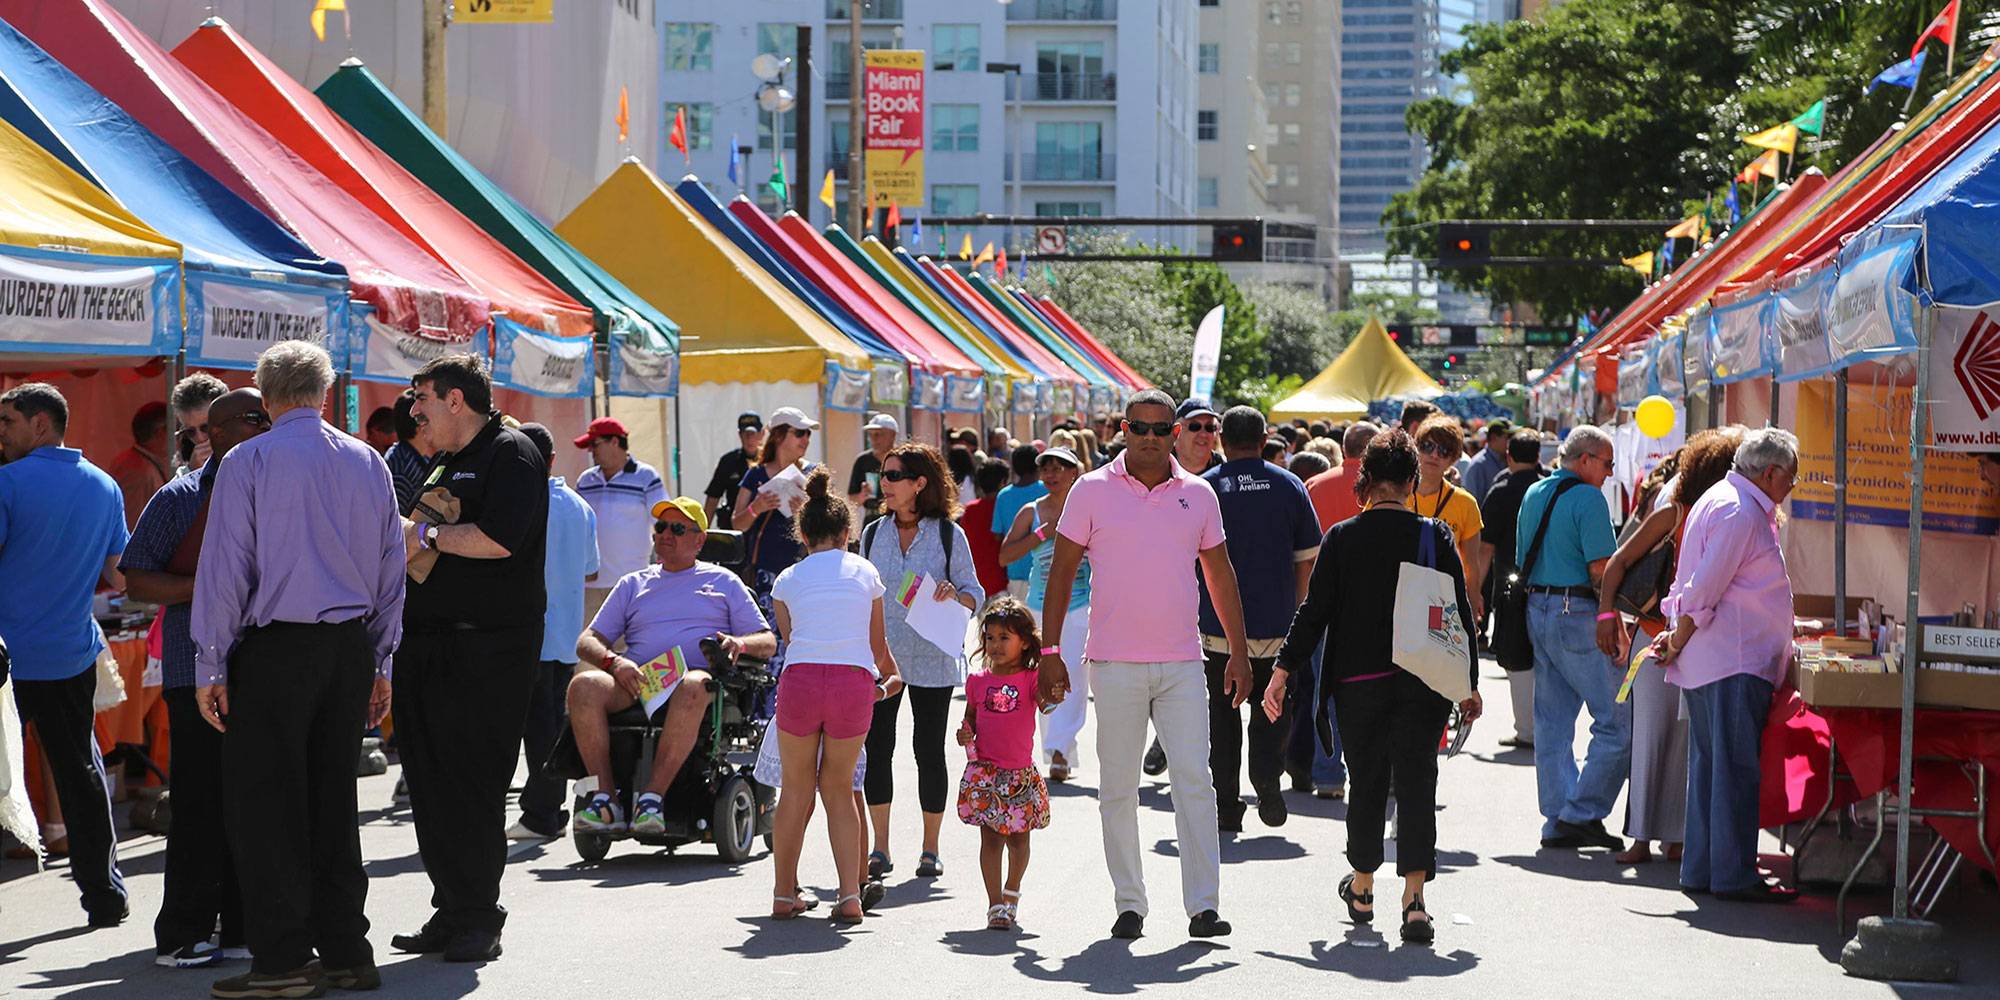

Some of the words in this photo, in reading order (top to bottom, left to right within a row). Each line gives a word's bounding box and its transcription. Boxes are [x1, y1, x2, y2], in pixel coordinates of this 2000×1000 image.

[868, 71, 921, 91] Miami
[868, 92, 920, 113] Book
[868, 114, 905, 135] Fair
[868, 136, 921, 147] International
[873, 176, 916, 188] miami
[57, 284, 79, 319] ON
[81, 286, 105, 321] THE
[106, 288, 146, 322] BEACH
[211, 306, 254, 340] MURDER
[256, 311, 273, 341] ON
[273, 313, 292, 341] THE
[1846, 440, 1905, 455] elcome
[1237, 474, 1254, 482] OHL
[1239, 482, 1271, 492] Arellano
[1923, 481, 1994, 498] scritores!
[1935, 633, 1962, 647] BEST
